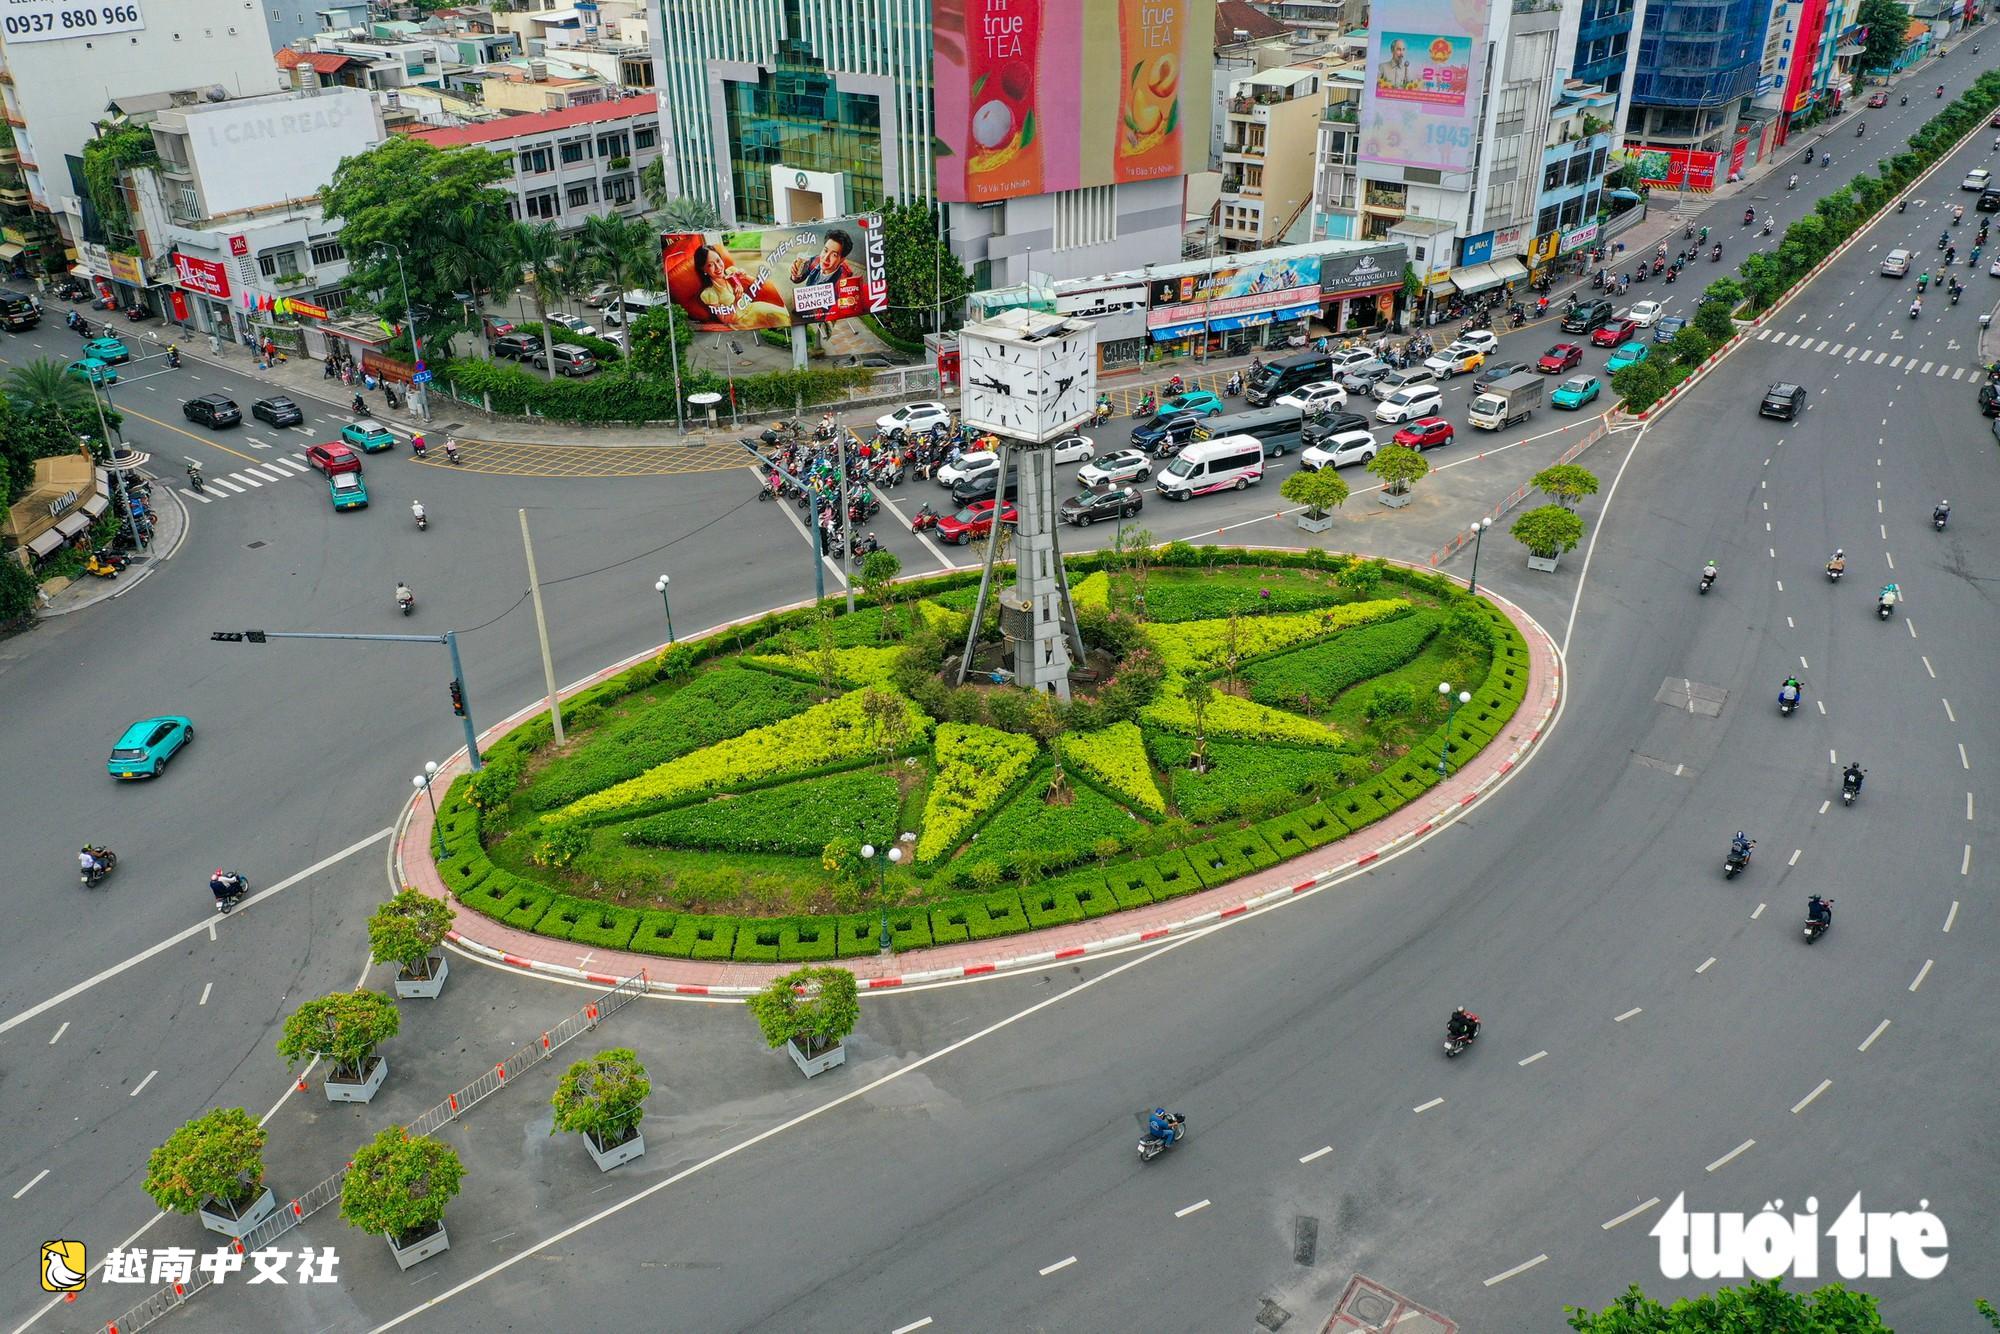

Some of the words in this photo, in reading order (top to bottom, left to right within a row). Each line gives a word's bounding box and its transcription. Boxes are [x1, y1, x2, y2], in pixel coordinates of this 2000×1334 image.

[5, 14, 54, 34] 0937
[61, 9, 97, 29] 880
[102, 5, 138, 24] 966
[984, 13, 1023, 35] true
[1142, 4, 1174, 25] true
[984, 35, 1022, 58] TEA
[1141, 24, 1172, 48] TEA
[1422, 68, 1453, 82] 2-9
[223, 118, 277, 145] CAN
[281, 108, 344, 135] READ
[1425, 124, 1470, 148] 1945
[709, 303, 736, 315] THÊM
[766, 239, 794, 267] THÊM
[796, 231, 817, 245] SỮA
[1332, 276, 1352, 286] TRANG
[1354, 273, 1385, 283] SHANGHAI
[1387, 270, 1398, 278] TEA
